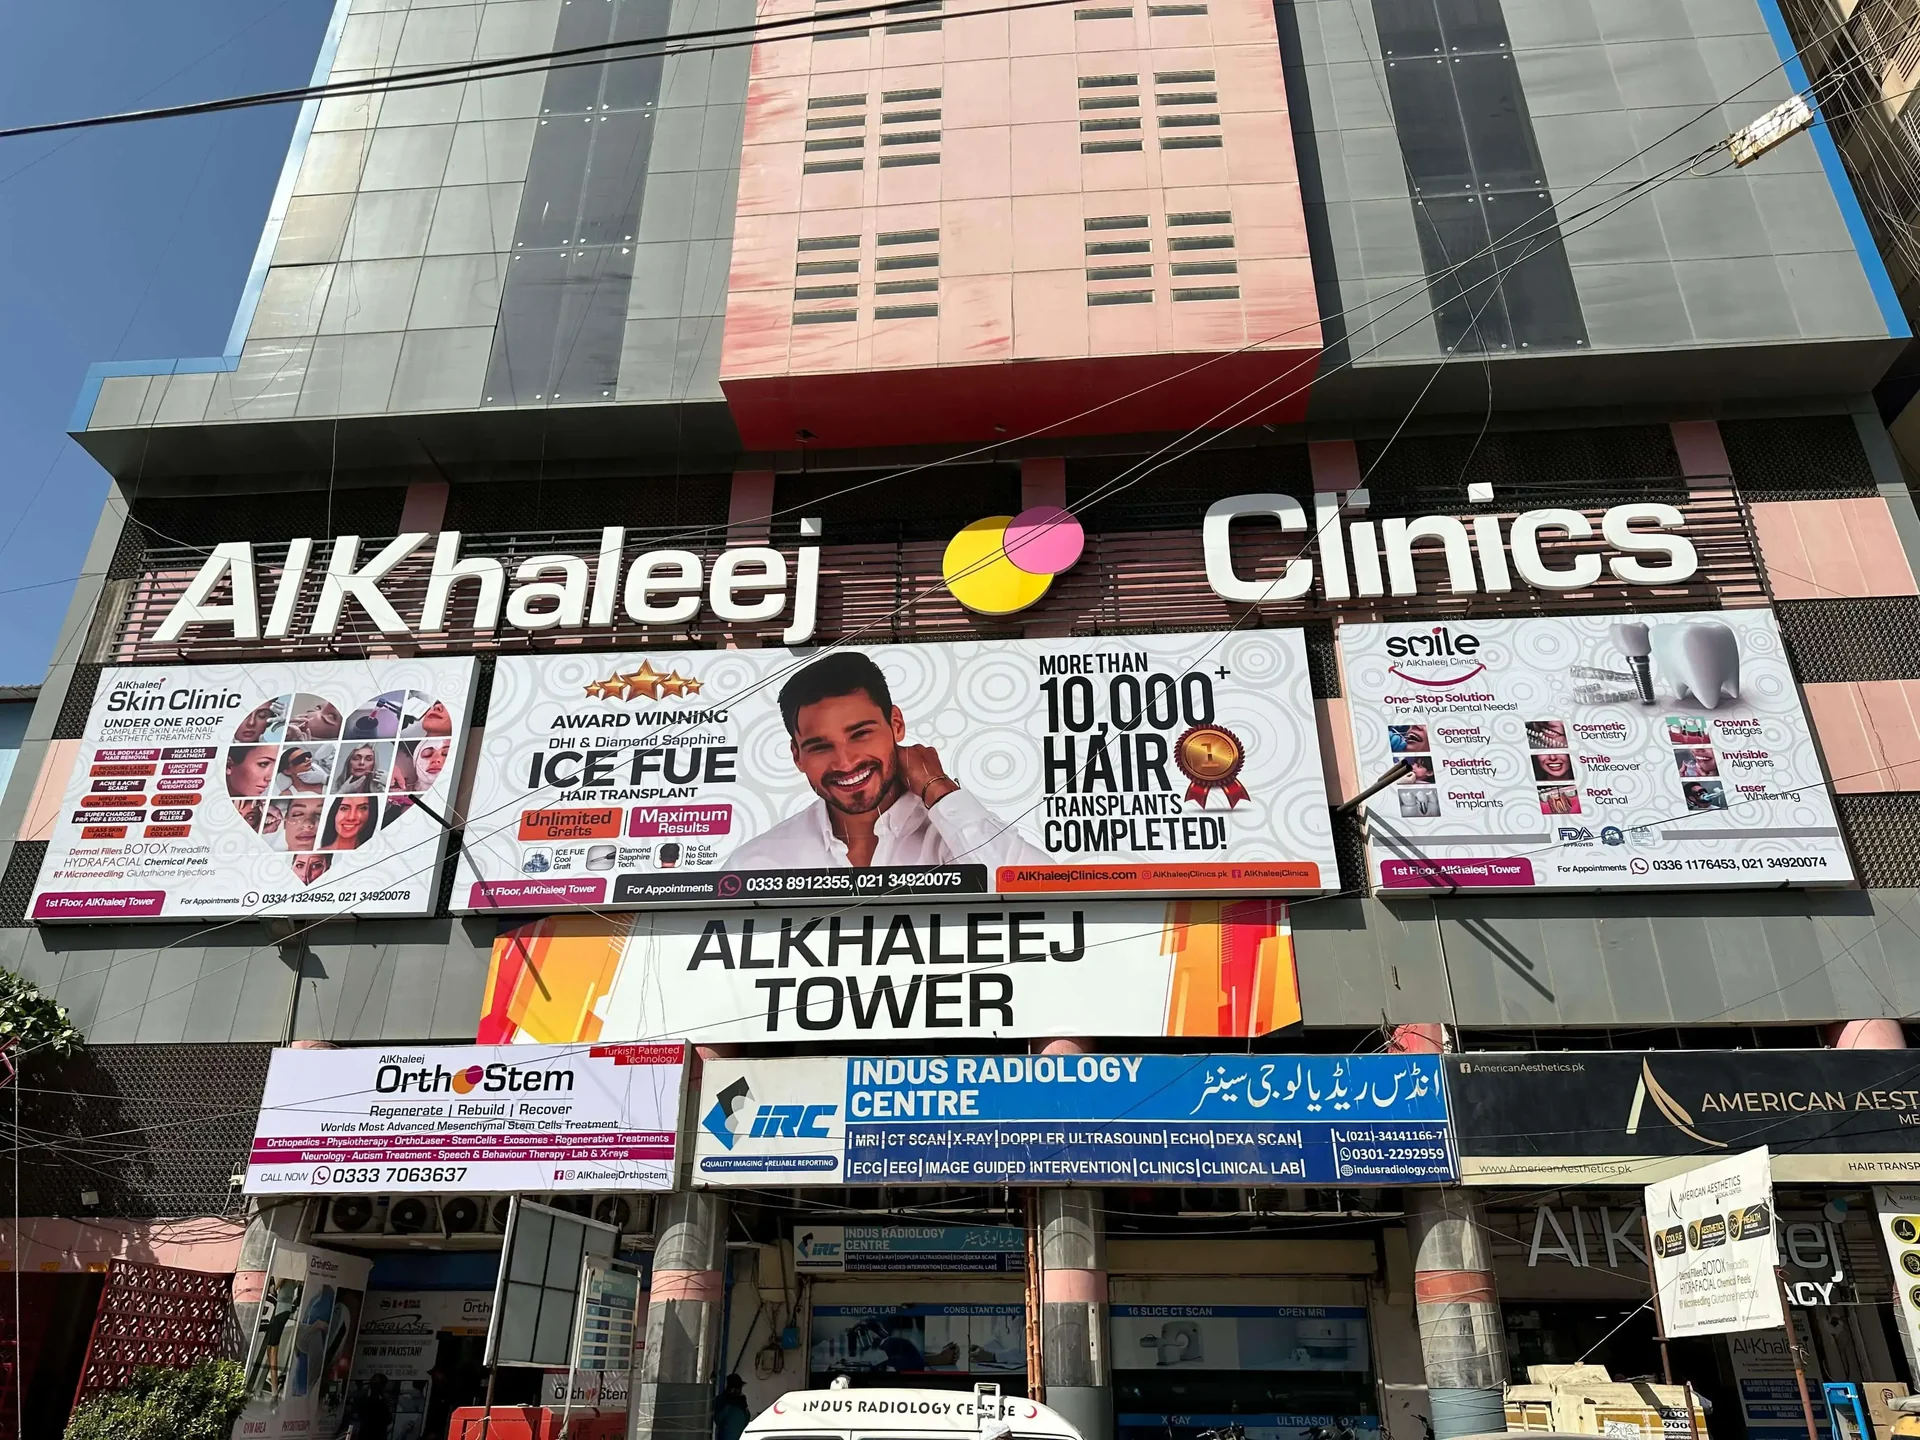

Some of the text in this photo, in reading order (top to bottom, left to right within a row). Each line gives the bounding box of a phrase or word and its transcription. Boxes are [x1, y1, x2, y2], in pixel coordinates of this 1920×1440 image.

[150, 482, 1698, 644] AlKhaleej Clinics
[1386, 627, 1480, 656] smile
[1039, 652, 1148, 675] MORE THAN
[1393, 657, 1479, 668] by AlKhaleej Clinics
[115, 678, 166, 690] AlKhaleej
[107, 688, 241, 711] Skin Clinic
[1384, 692, 1494, 704] One-Stop Solution
[1395, 702, 1518, 715] For All your Dental Needs!
[104, 716, 224, 728] UNDER ONE ROOF
[550, 709, 729, 729] AWARD WINNING
[1714, 718, 1760, 727] Crown &
[1437, 727, 1480, 736] General
[1573, 722, 1626, 732] Cosmetic
[1722, 726, 1762, 736] Bridges
[549, 733, 726, 749] DHI & Diamond Sapphire
[1445, 734, 1491, 745] Dentistry
[1581, 730, 1627, 741] Dentistry
[1579, 755, 1611, 764] Smile
[1722, 750, 1768, 760] Invisible
[528, 746, 738, 789] ICE FUE
[1043, 733, 1173, 794] HAIR
[1443, 758, 1492, 767] Pediatric
[1588, 762, 1640, 772] Makeover
[1731, 758, 1774, 769] Aligners
[1451, 766, 1497, 777] Dentistry
[560, 787, 698, 801] HAIR TRANSPLANT
[1587, 787, 1613, 796] Root
[1735, 783, 1766, 793] Laser
[1448, 791, 1485, 800] Dental
[1595, 795, 1629, 805] Canal
[1744, 791, 1800, 802] Whitening
[1044, 794, 1182, 817] TRANSPLANTS
[1456, 798, 1503, 810] Implants
[526, 811, 611, 827] Unlimited
[639, 808, 728, 823] Maximum
[547, 826, 592, 837] Grafts
[658, 822, 709, 833] Results
[1044, 817, 1227, 853] COMPLETED!
[1558, 827, 1594, 841] FDA
[69, 847, 99, 855] Dermal
[101, 847, 123, 855] Fillers
[123, 843, 169, 855] BOTOX
[63, 857, 208, 867] HYDRAFACIAL Chemical Peels
[1653, 857, 1827, 872] 0336 1176453, 021 34920074
[1017, 869, 1309, 882] AlKhaleejClinics.com AlKhaleejClinics.pk AlKhaleejClinics
[627, 873, 961, 895] For Appointments 0333 8912355, 021 34920075
[262, 890, 410, 904] 0334 1324952, 021 34920078
[687, 910, 1085, 971] ALKHALEEJ
[754, 973, 1014, 1033] TOWER
[603, 1045, 680, 1057] Turkish Patented
[379, 1054, 425, 1065] AlKhaleej
[625, 1054, 678, 1065] Technology
[852, 1057, 1143, 1086] INDUS RADIOLOGY
[1474, 1063, 1585, 1074] AmericanAesthetics.pk
[851, 1090, 979, 1117] CENTRE
[1701, 1091, 1845, 1113] AMERICAN
[369, 1103, 572, 1118] Regenerate Rebuild Recover
[320, 1119, 618, 1133] Worlds Most Advanced Mesenchymal Stem Cells Treatment
[1346, 1130, 1443, 1142] (021)-34141166-7
[1352, 1148, 1444, 1161] 0301-2292959
[768, 1159, 796, 1167] RELIABLE
[798, 1159, 833, 1167] REPORTING
[1479, 1163, 1632, 1175] www.AmericanAesthetics.pk
[333, 1167, 467, 1183] 0333 7063637
[576, 1170, 668, 1181] AlKhaleejOrthostem
[1354, 1164, 1449, 1176] indusradiology.com
[260, 1172, 308, 1183] CALL NOW
[845, 1229, 945, 1239] INDUS RADIOLOGY
[845, 1240, 890, 1249] CENTRE
[1702, 1258, 1726, 1275] BOTOX
[1140, 1307, 1168, 1316] SLICE
[1170, 1307, 1184, 1316] CT
[1185, 1307, 1212, 1316] SCAN
[1279, 1308, 1326, 1317] OPEN MRI
[858, 1400, 951, 1415] RADIOLOGY
